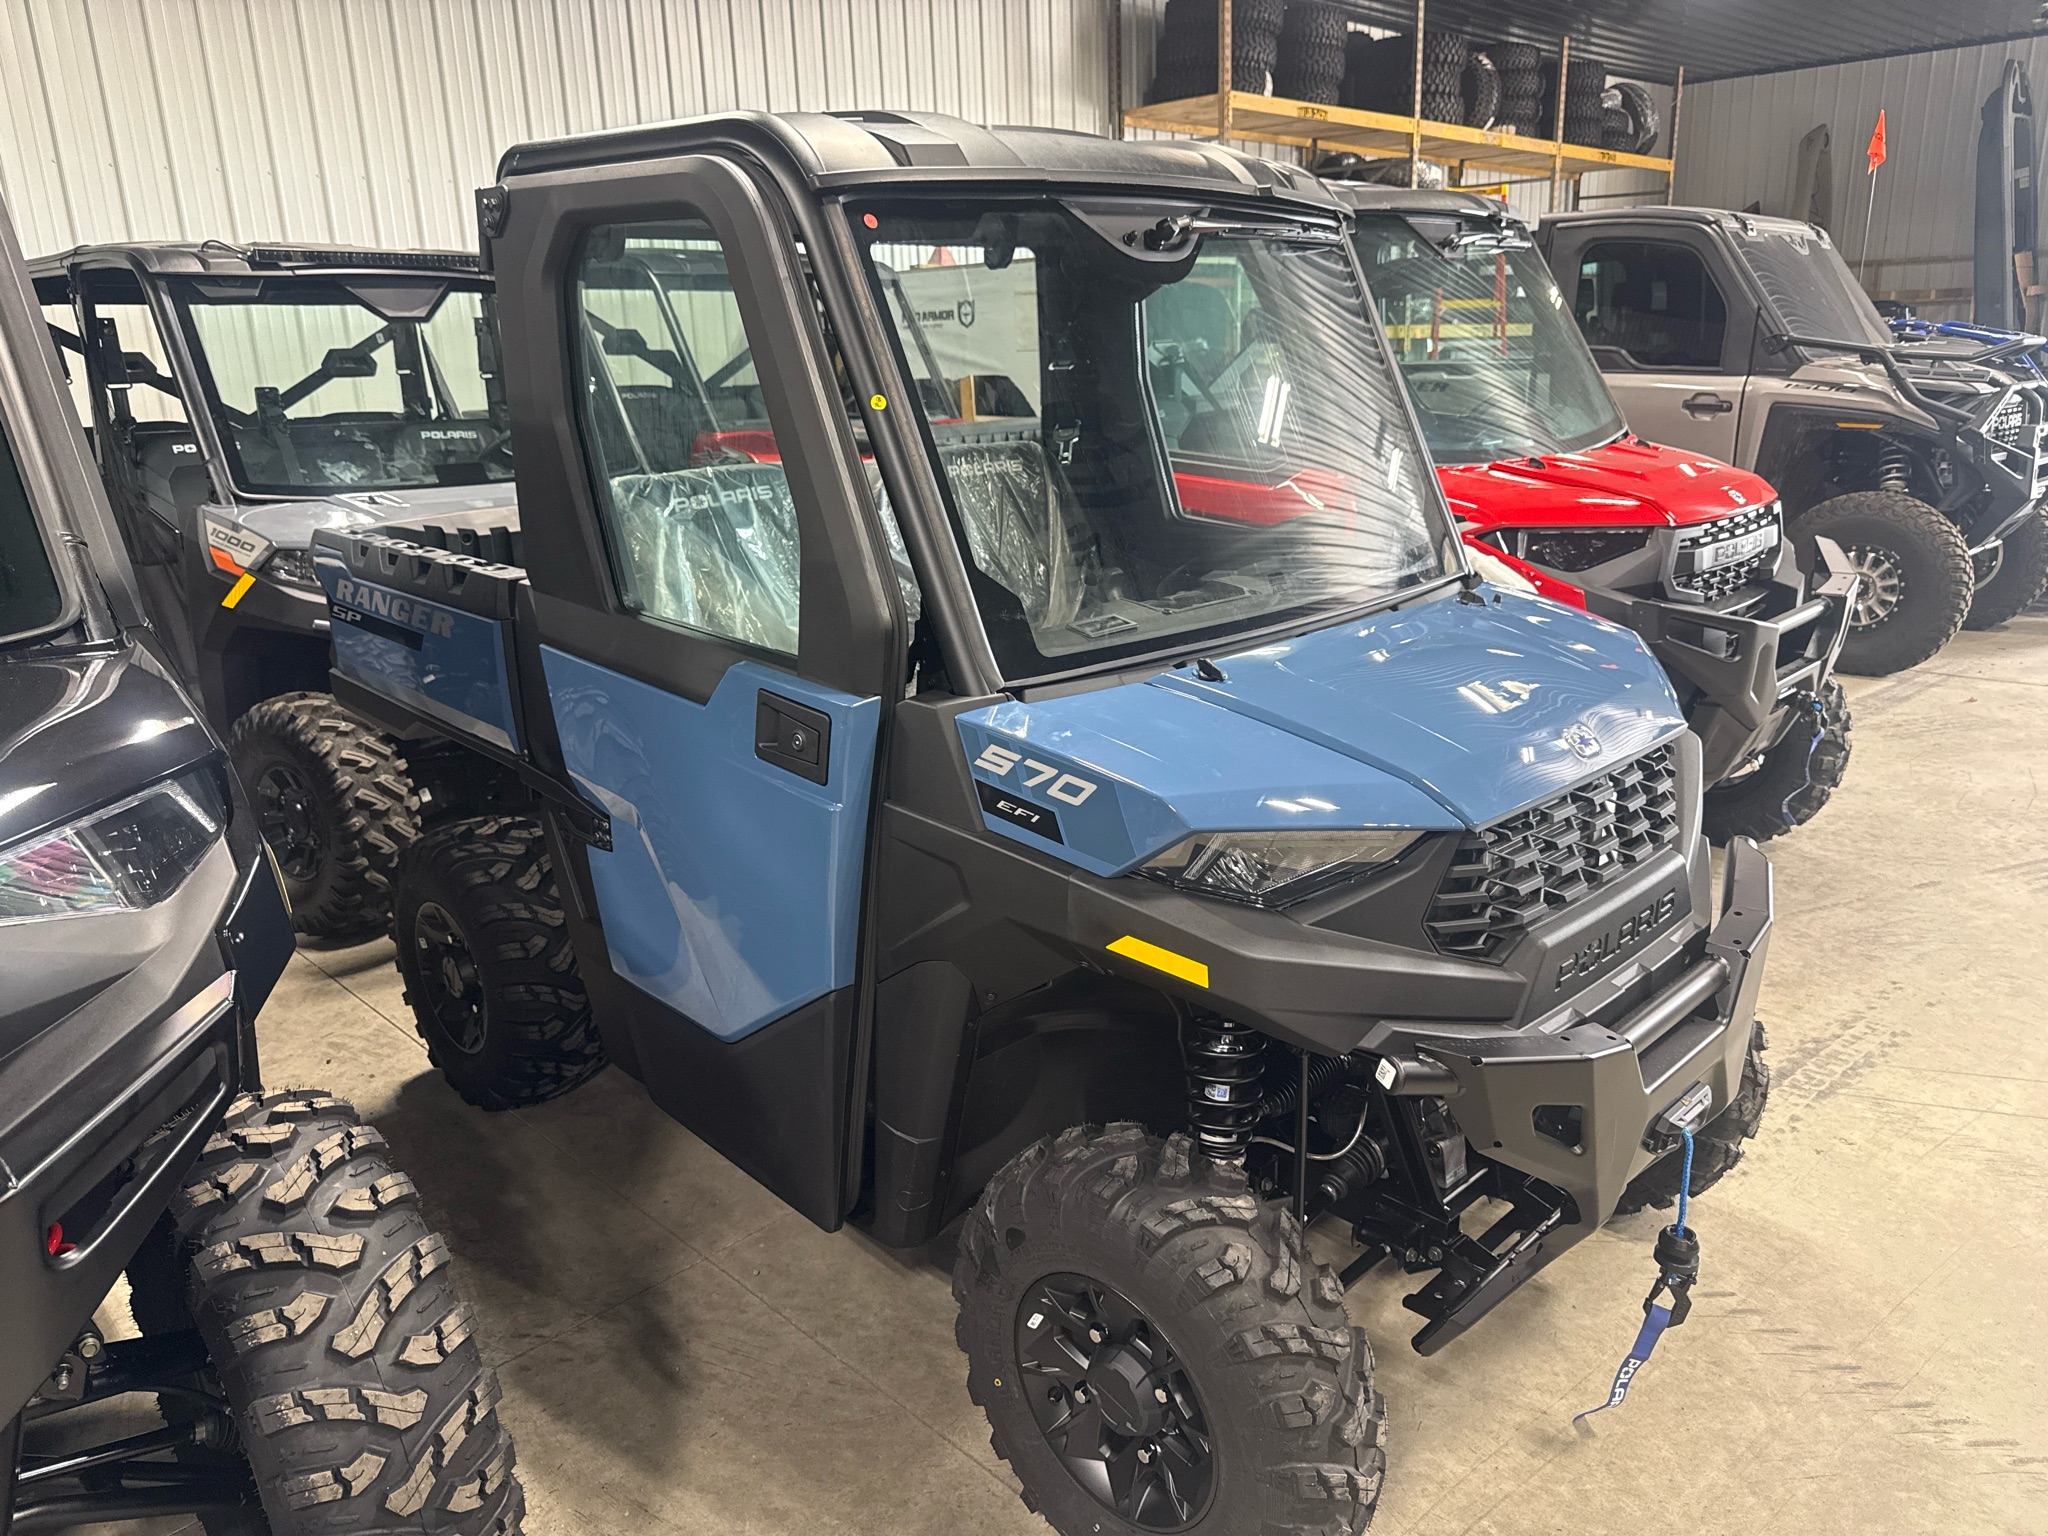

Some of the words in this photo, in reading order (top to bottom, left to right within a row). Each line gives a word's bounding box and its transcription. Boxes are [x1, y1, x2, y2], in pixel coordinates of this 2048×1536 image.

[1784, 383, 1857, 393] 1500
[1990, 412, 2022, 433] POLARIS
[420, 430, 477, 440] POLARIS
[947, 459, 1023, 478] POLARIS
[674, 484, 773, 513] POLARIS
[210, 527, 256, 553] 1000
[1715, 532, 1763, 562] POLARIS
[332, 605, 362, 622] SP
[336, 578, 455, 639] RANGER
[973, 743, 1098, 807] 570
[996, 800, 1041, 823] EFI
[1554, 887, 1676, 993] POLARIS
